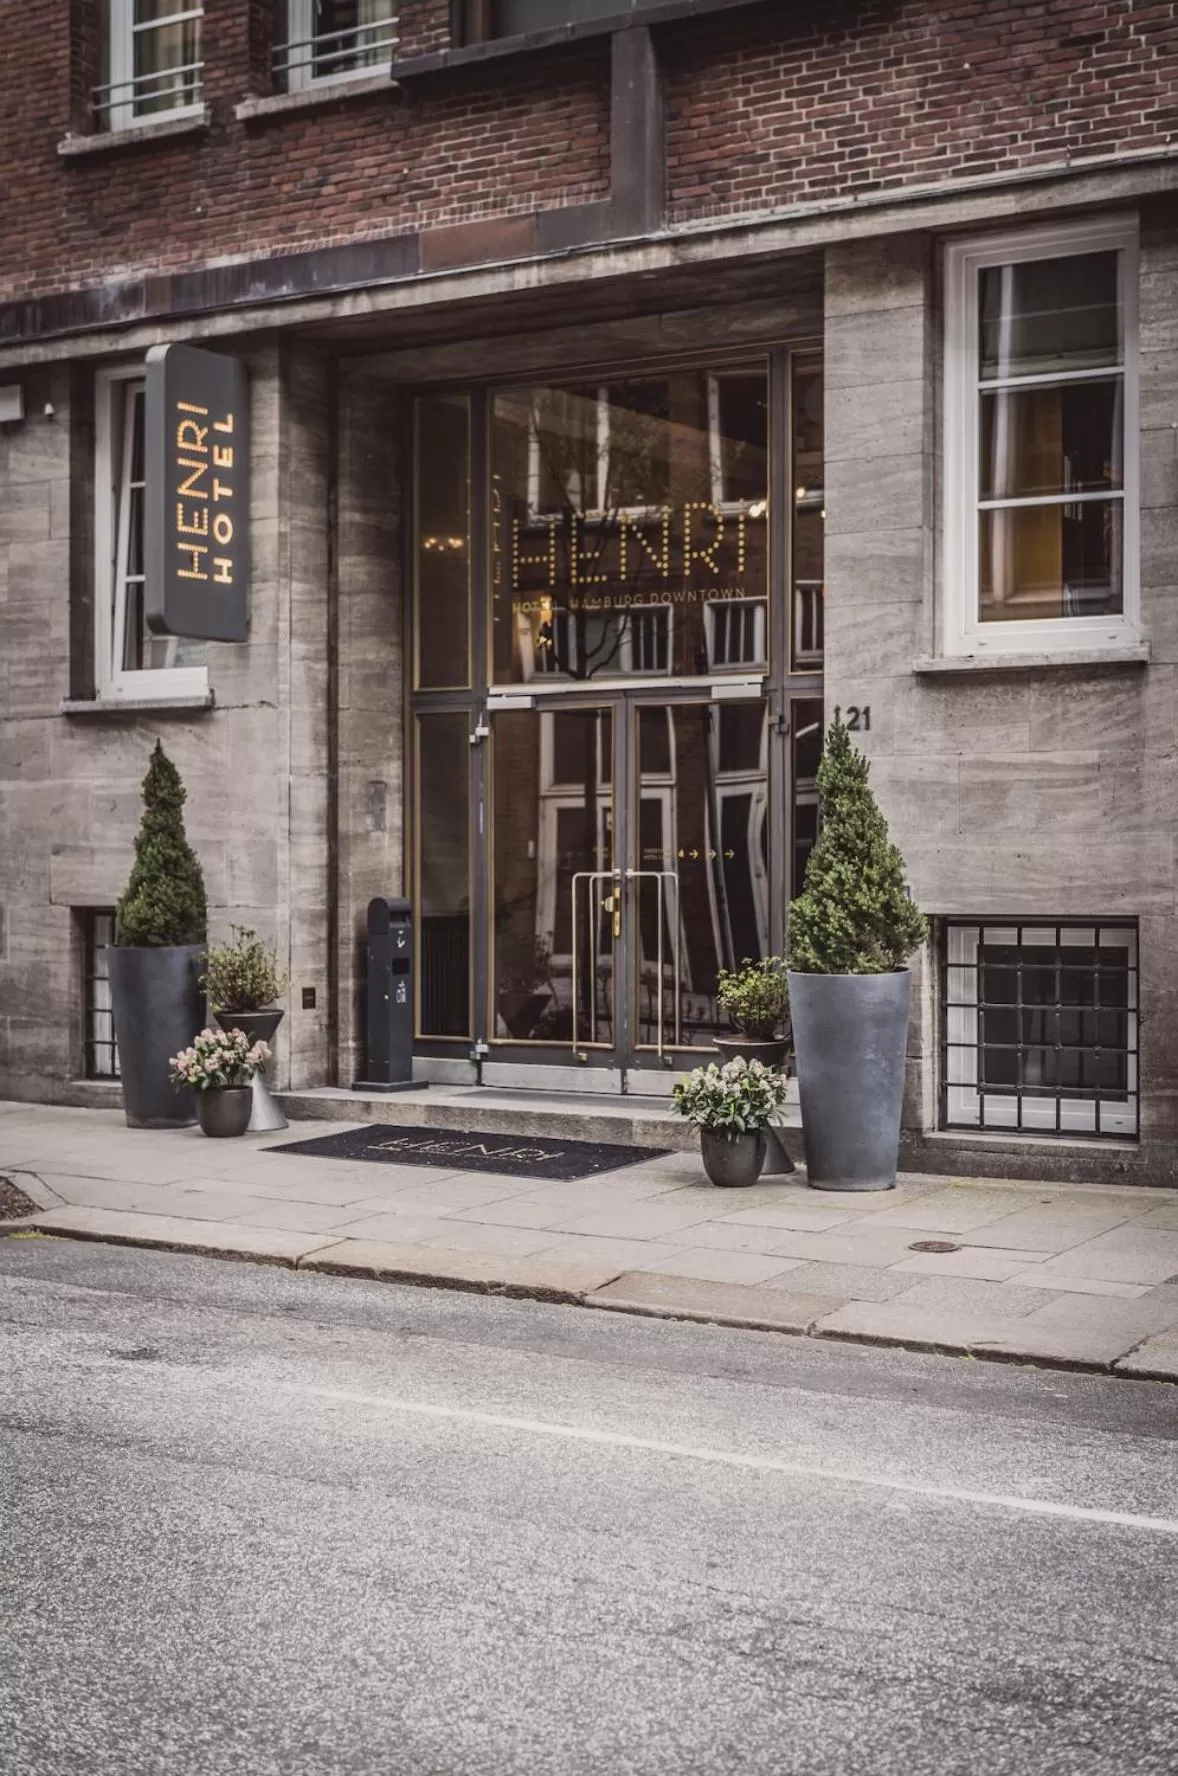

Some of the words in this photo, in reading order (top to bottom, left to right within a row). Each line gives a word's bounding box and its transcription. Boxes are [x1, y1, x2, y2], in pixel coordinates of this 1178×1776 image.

[177, 401, 208, 580] HENRI
[213, 413, 233, 583] HOTEL
[512, 499, 745, 588] HENRI
[513, 599, 556, 612] HOT
[570, 593, 644, 609] HAMBURG
[650, 587, 745, 604] DOWNTOWN
[847, 706, 870, 731] 21
